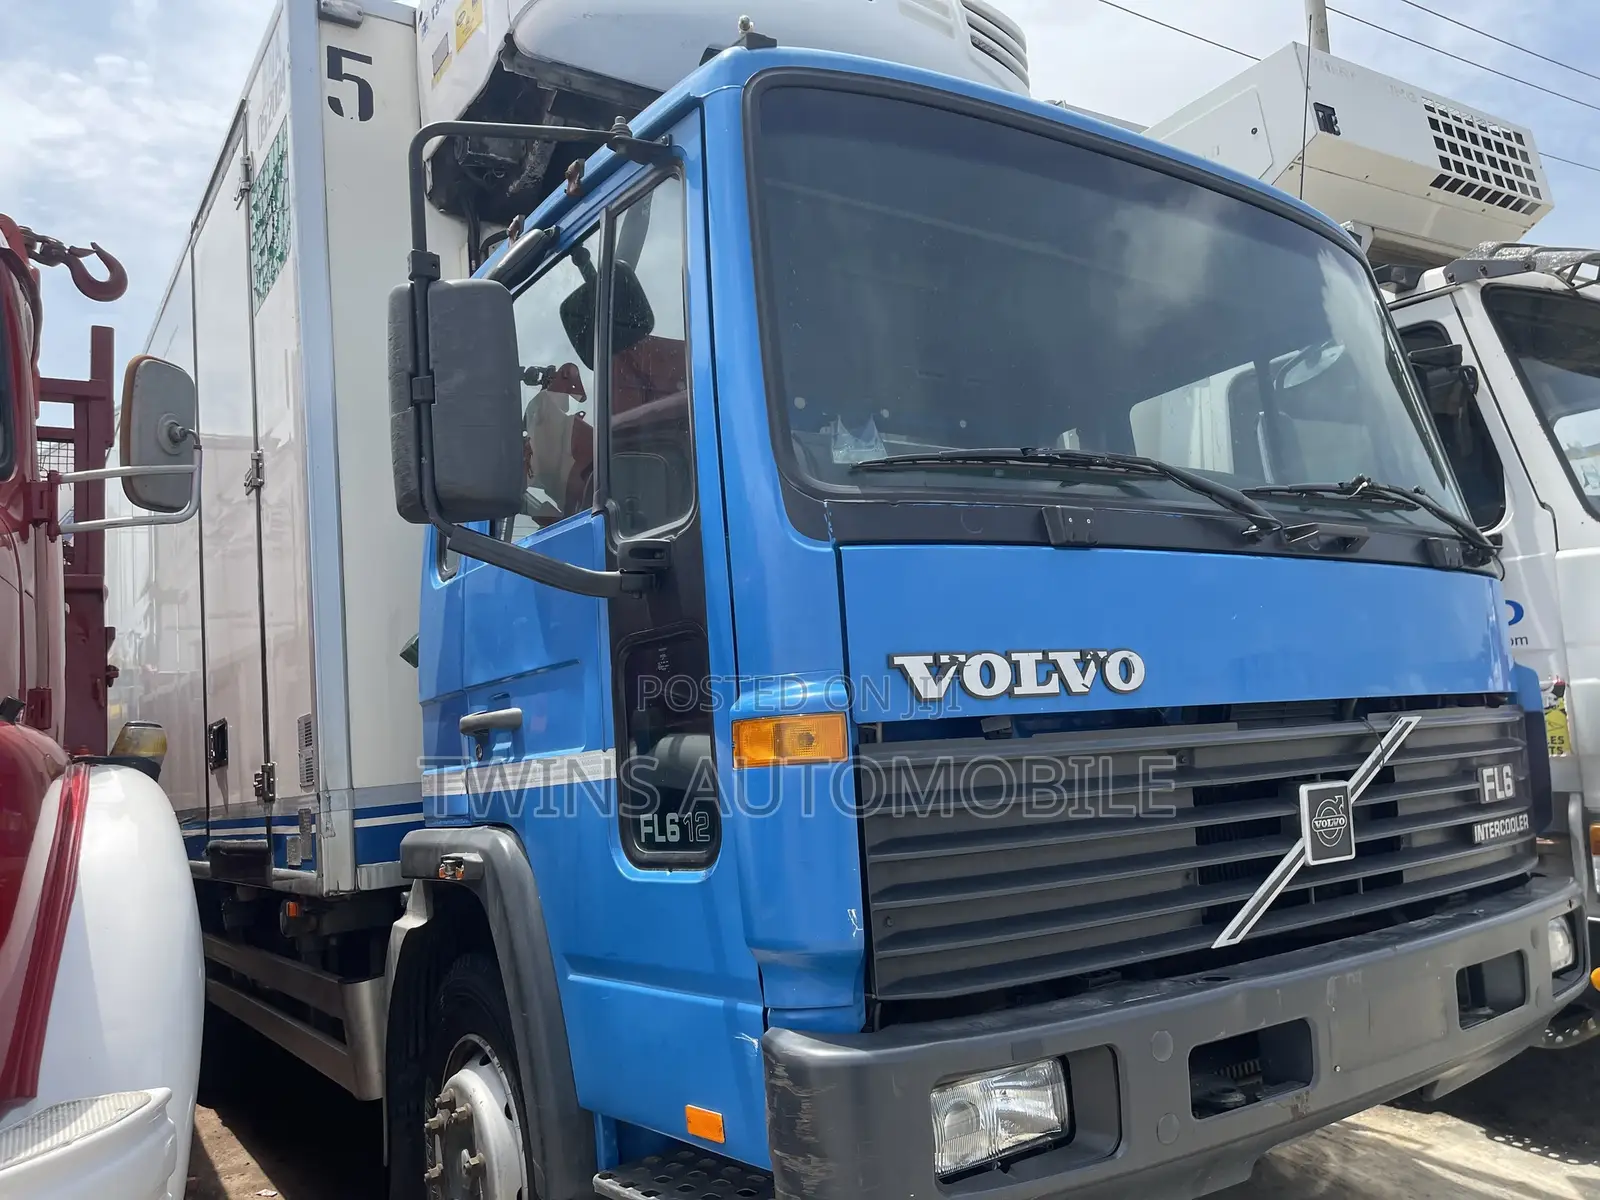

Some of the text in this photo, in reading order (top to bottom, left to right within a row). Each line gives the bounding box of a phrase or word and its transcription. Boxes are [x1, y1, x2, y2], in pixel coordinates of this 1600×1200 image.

[326, 45, 374, 122] 5
[893, 650, 1146, 701] VOLVO
[1547, 735, 1565, 745] ES
[1482, 765, 1514, 801] FL6
[1314, 817, 1345, 828] VOLVO
[1474, 813, 1530, 842] INTERCOOLER
